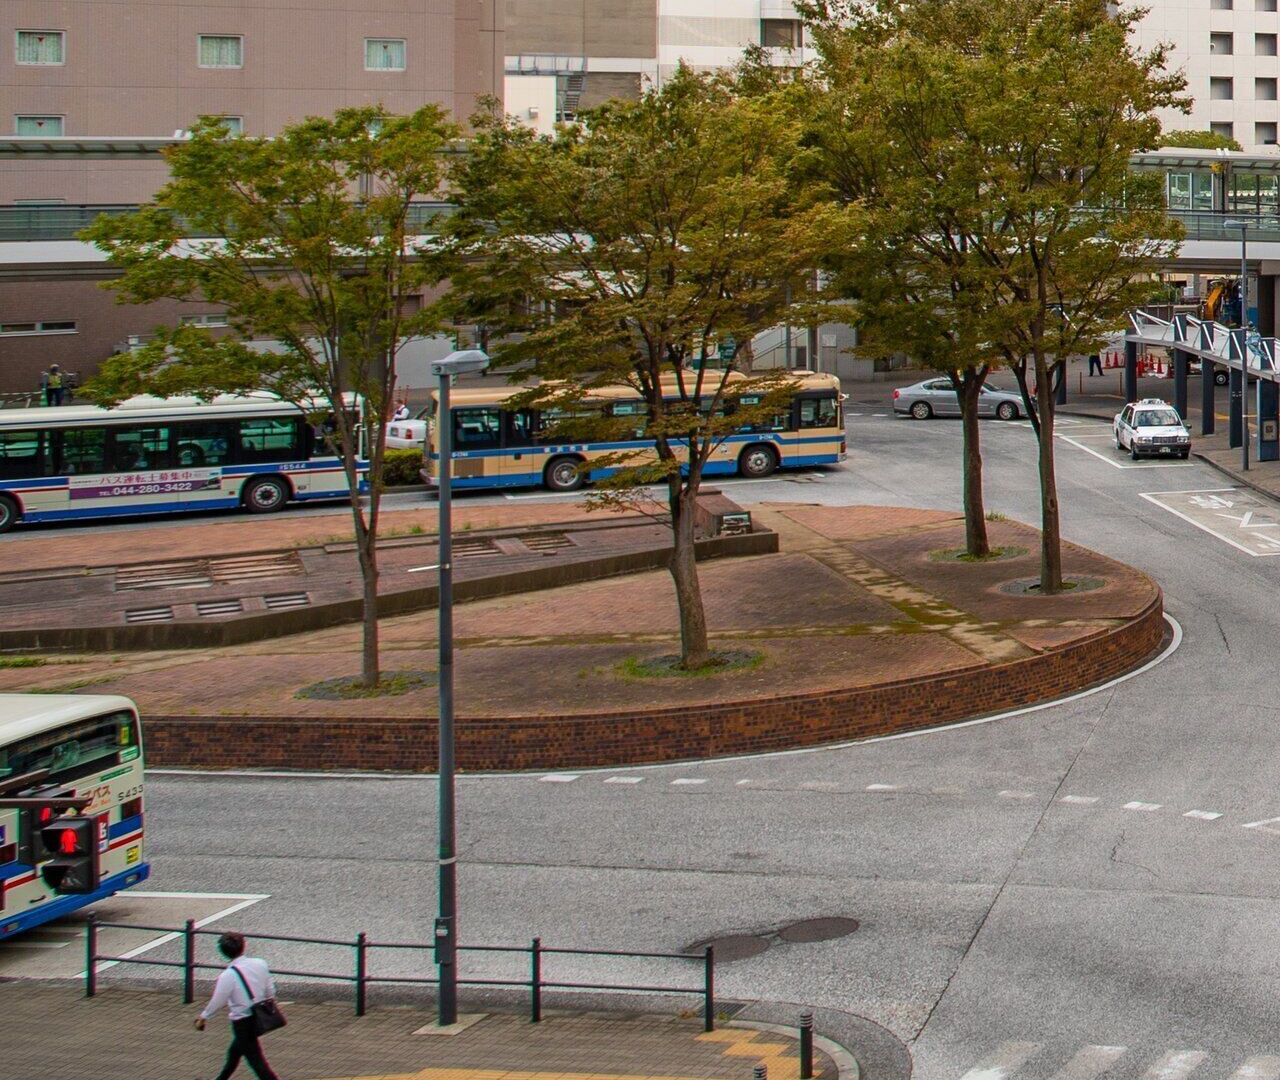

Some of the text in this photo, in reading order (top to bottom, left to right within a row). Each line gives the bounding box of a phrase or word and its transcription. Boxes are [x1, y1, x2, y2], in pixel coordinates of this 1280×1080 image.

[100, 471, 193, 485] バス運転士募集中
[113, 482, 193, 496] 044-280-3422
[118, 783, 144, 802] S433
